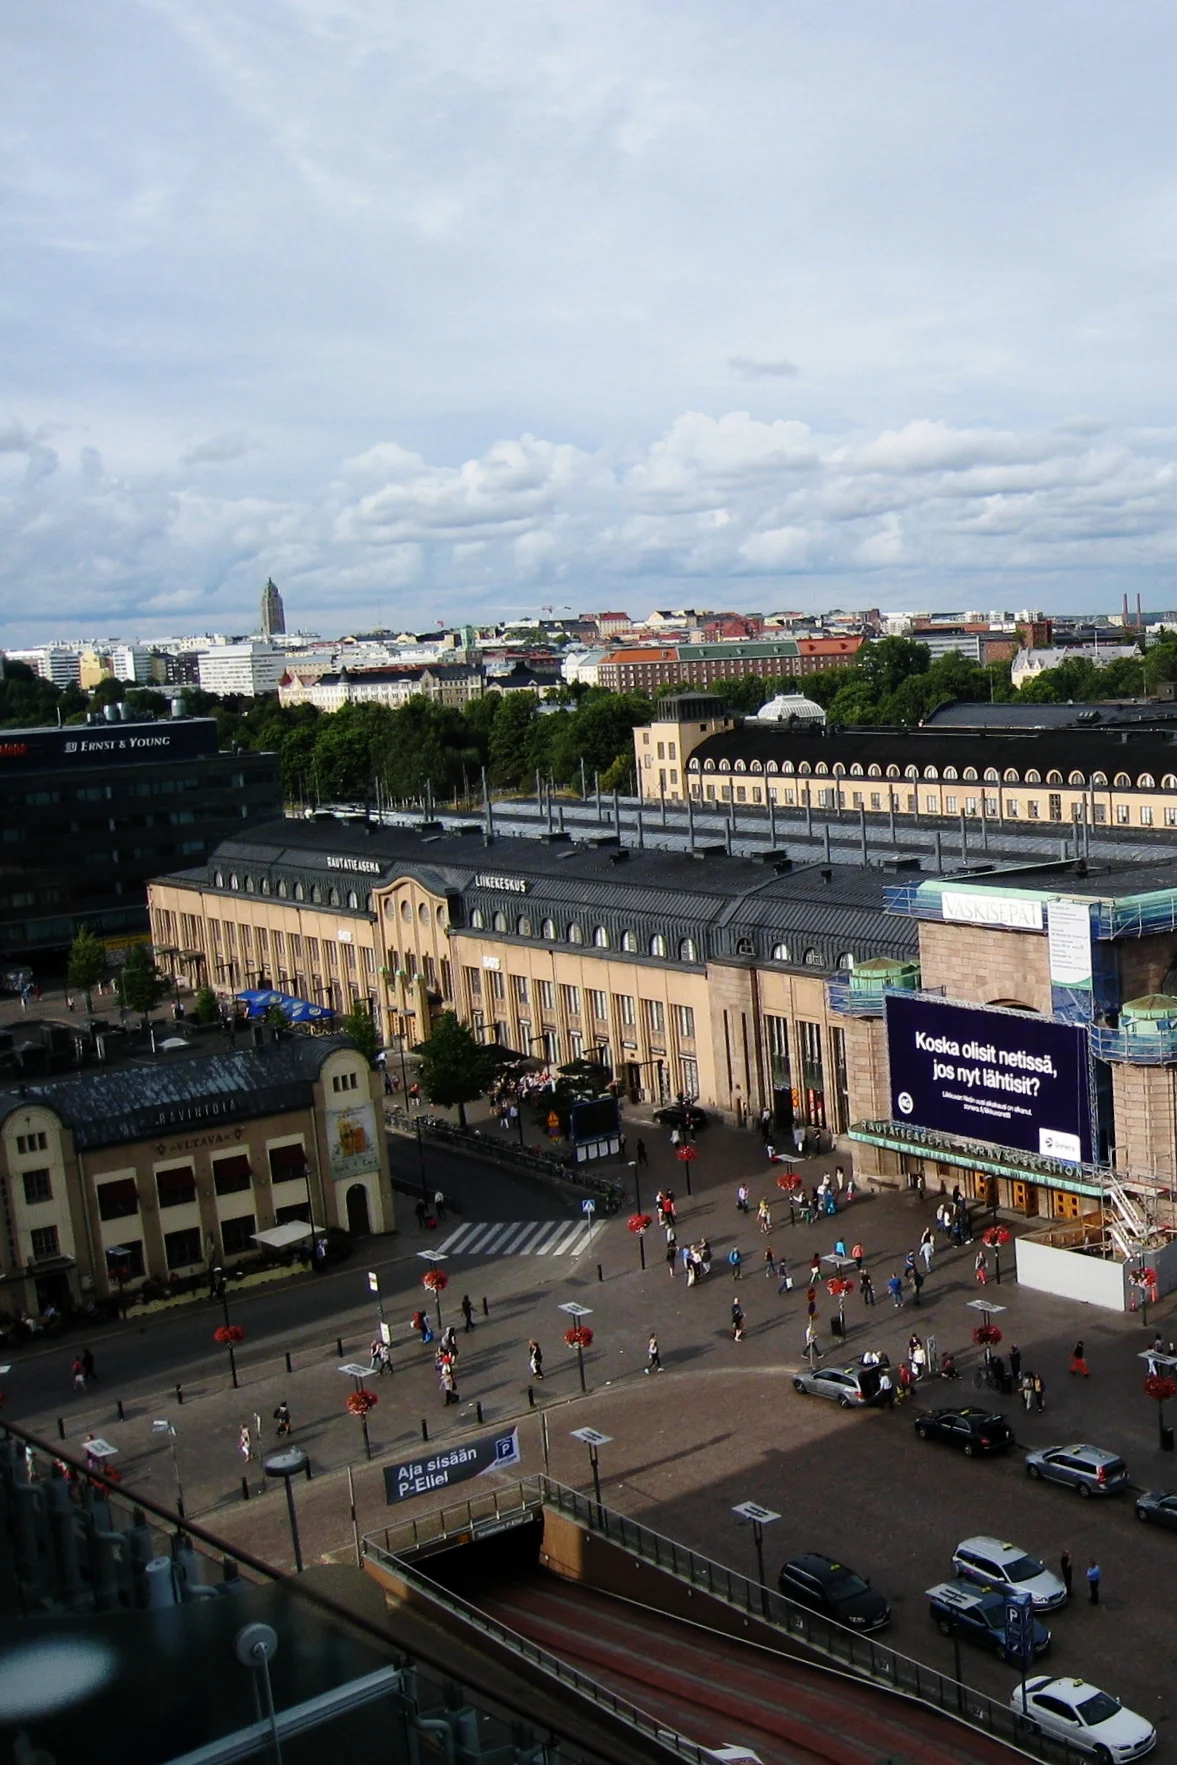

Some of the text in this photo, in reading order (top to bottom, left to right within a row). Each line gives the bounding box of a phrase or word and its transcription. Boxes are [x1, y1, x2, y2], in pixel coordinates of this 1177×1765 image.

[81, 736, 170, 752] ERNST & YOUNG
[326, 856, 380, 874] RAUTATIEASEMA
[475, 875, 525, 893] LIIKEKESKUS
[944, 895, 1040, 926] VASKISEPÄT
[915, 1031, 1057, 1079] Koska olisit netissä,
[932, 1059, 1040, 1097] jos nyt lähtisit?
[159, 1099, 236, 1125] RAVINTOLA
[176, 1133, 224, 1151] VLTAVA
[861, 1119, 952, 1149] RAUTATIEASEMA
[501, 1443, 511, 1455] P
[398, 1466, 423, 1481] Aja
[427, 1448, 477, 1472] sisään
[398, 1471, 448, 1497] P-Eliel
[1009, 1608, 1018, 1622] P
